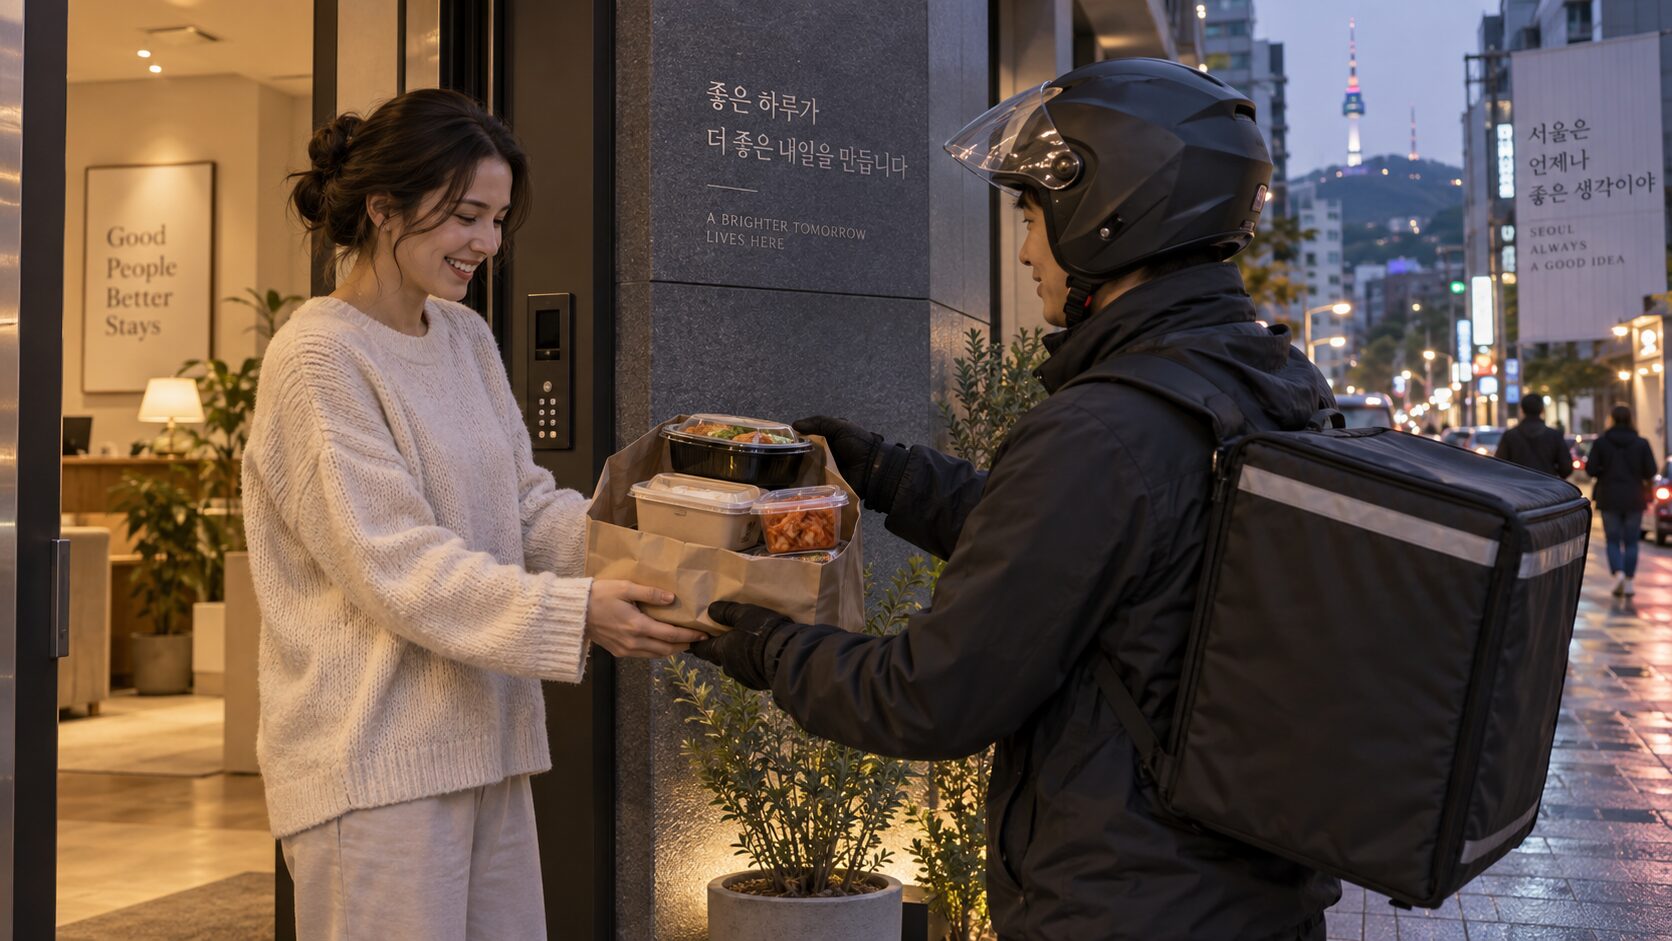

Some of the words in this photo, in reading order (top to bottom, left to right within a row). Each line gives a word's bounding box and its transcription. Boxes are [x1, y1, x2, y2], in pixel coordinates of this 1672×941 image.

[706, 80, 752, 115] 좋은
[757, 90, 820, 126] 하루가
[1528, 118, 1591, 145] 서울은
[707, 126, 726, 156] 더
[732, 130, 774, 161] 좋은
[778, 137, 835, 170] 내일을
[839, 145, 909, 180] 만듭니다
[1529, 149, 1590, 177] 언제나
[1528, 183, 1569, 207] 좋은
[1574, 171, 1656, 201] 생각이야
[106, 224, 166, 248] Good
[706, 212, 716, 225] A
[721, 213, 789, 233] BRIGHTER
[793, 221, 867, 241] TOMORROW
[706, 230, 746, 247] LIVES
[750, 236, 785, 250] HERE
[1529, 224, 1575, 239] SEOUL
[1529, 239, 1588, 256] ALWAYS
[107, 255, 177, 283] People
[1530, 262, 1539, 273] A
[1544, 257, 1586, 272] GOOD
[1591, 254, 1626, 267] IDEA
[107, 287, 173, 308] Better
[105, 314, 162, 342] Stays
